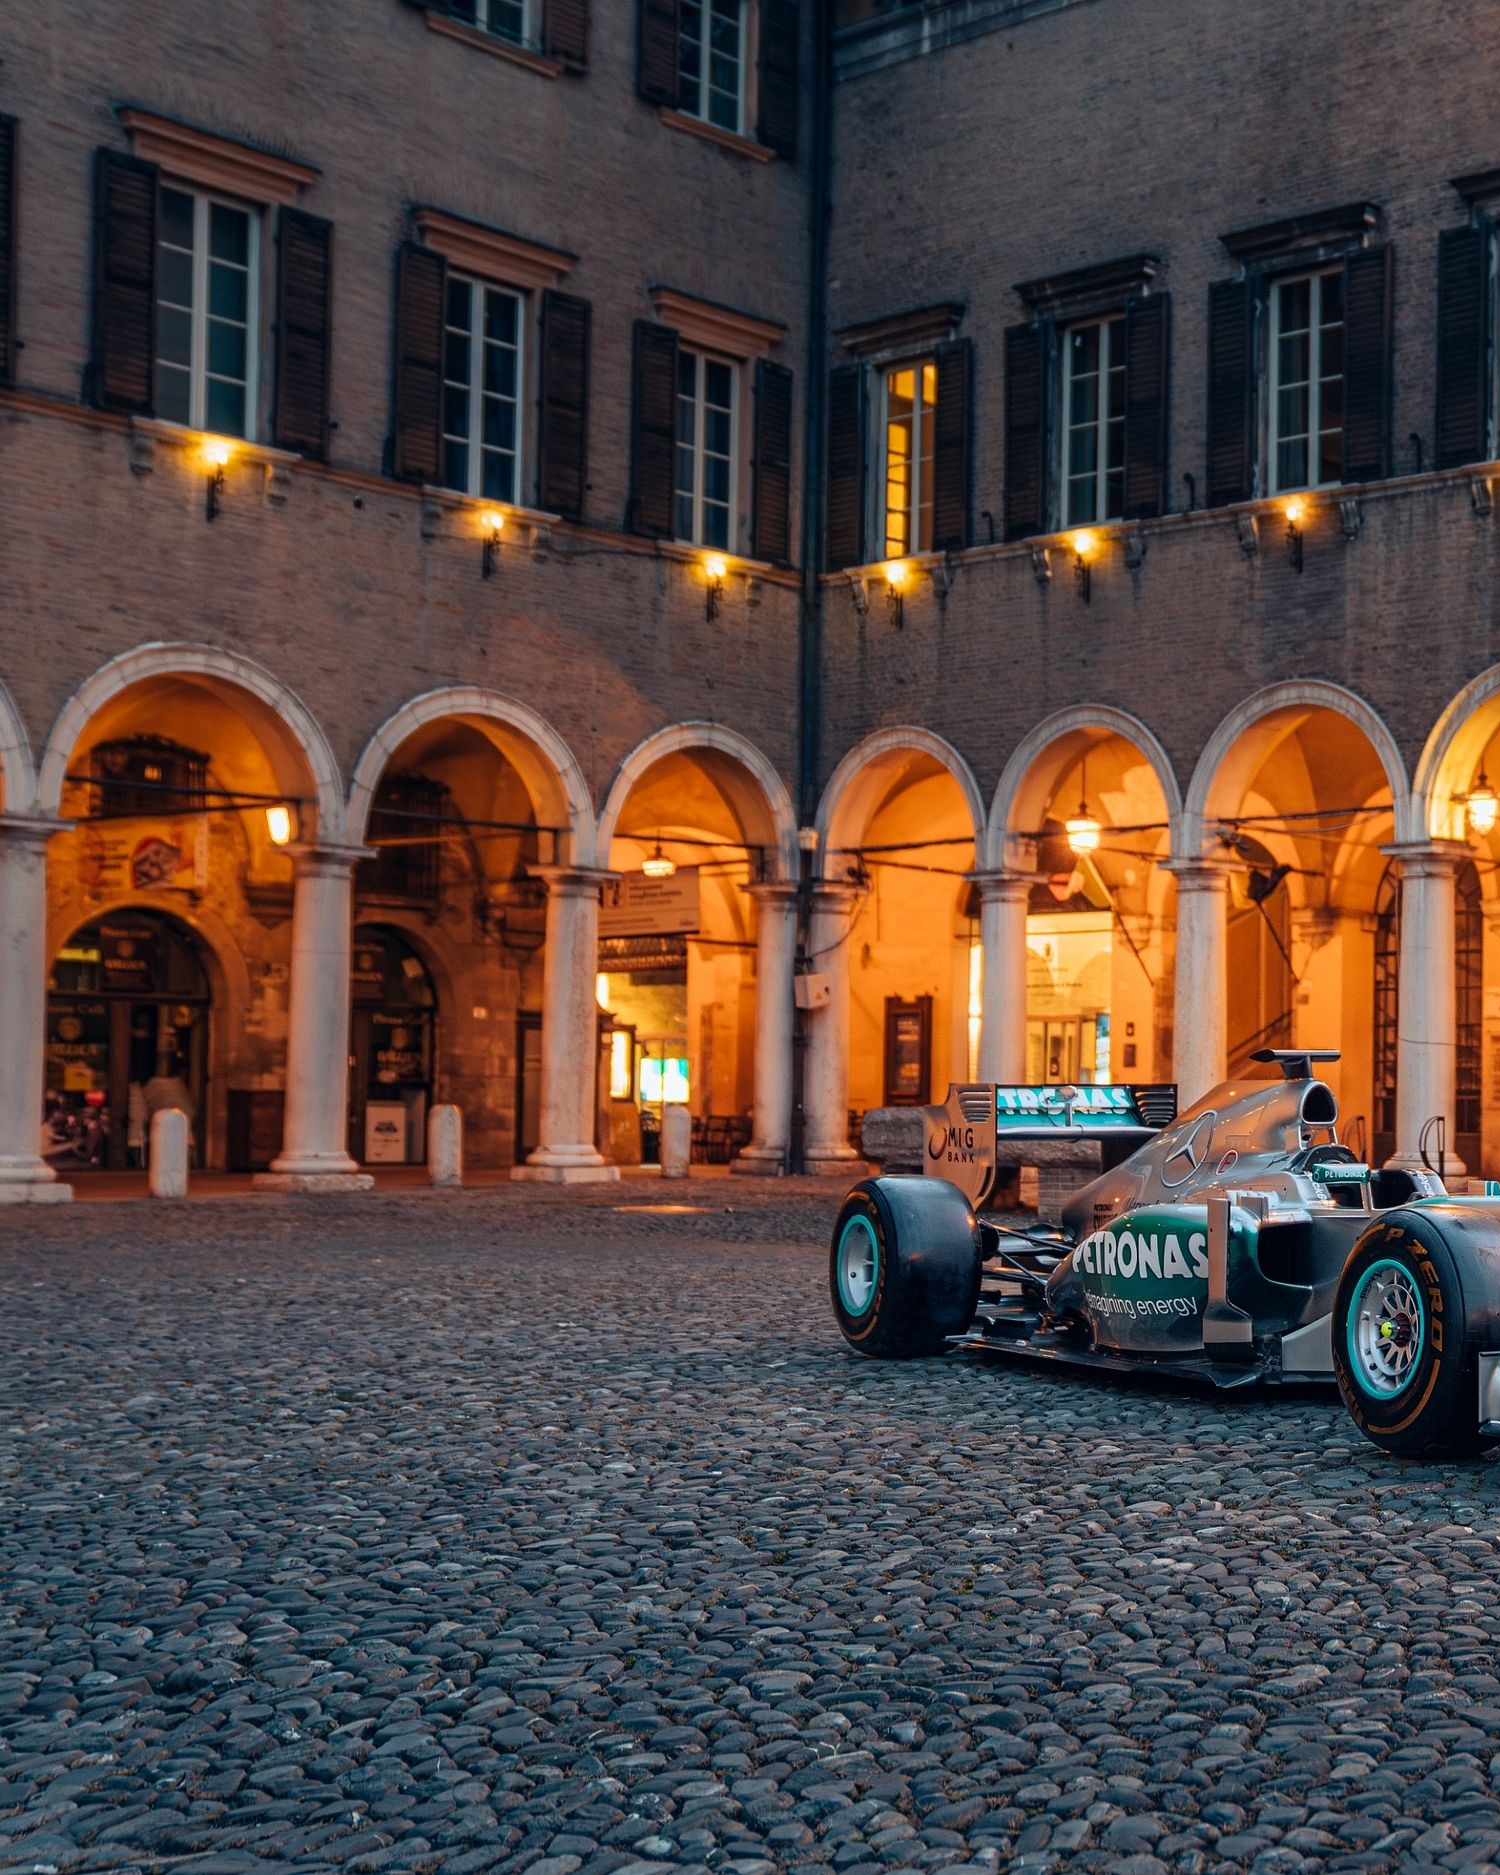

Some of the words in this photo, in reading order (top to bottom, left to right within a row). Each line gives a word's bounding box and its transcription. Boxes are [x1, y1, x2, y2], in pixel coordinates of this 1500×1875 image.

[948, 1127, 974, 1149] MIG
[948, 1153, 975, 1164] BANK
[1324, 1170, 1366, 1178] PETRONAS
[1072, 1231, 1208, 1279] PETRONAS
[1384, 1227, 1405, 1243] P
[1407, 1238, 1444, 1352] ZERO
[1136, 1296, 1198, 1316] energy
